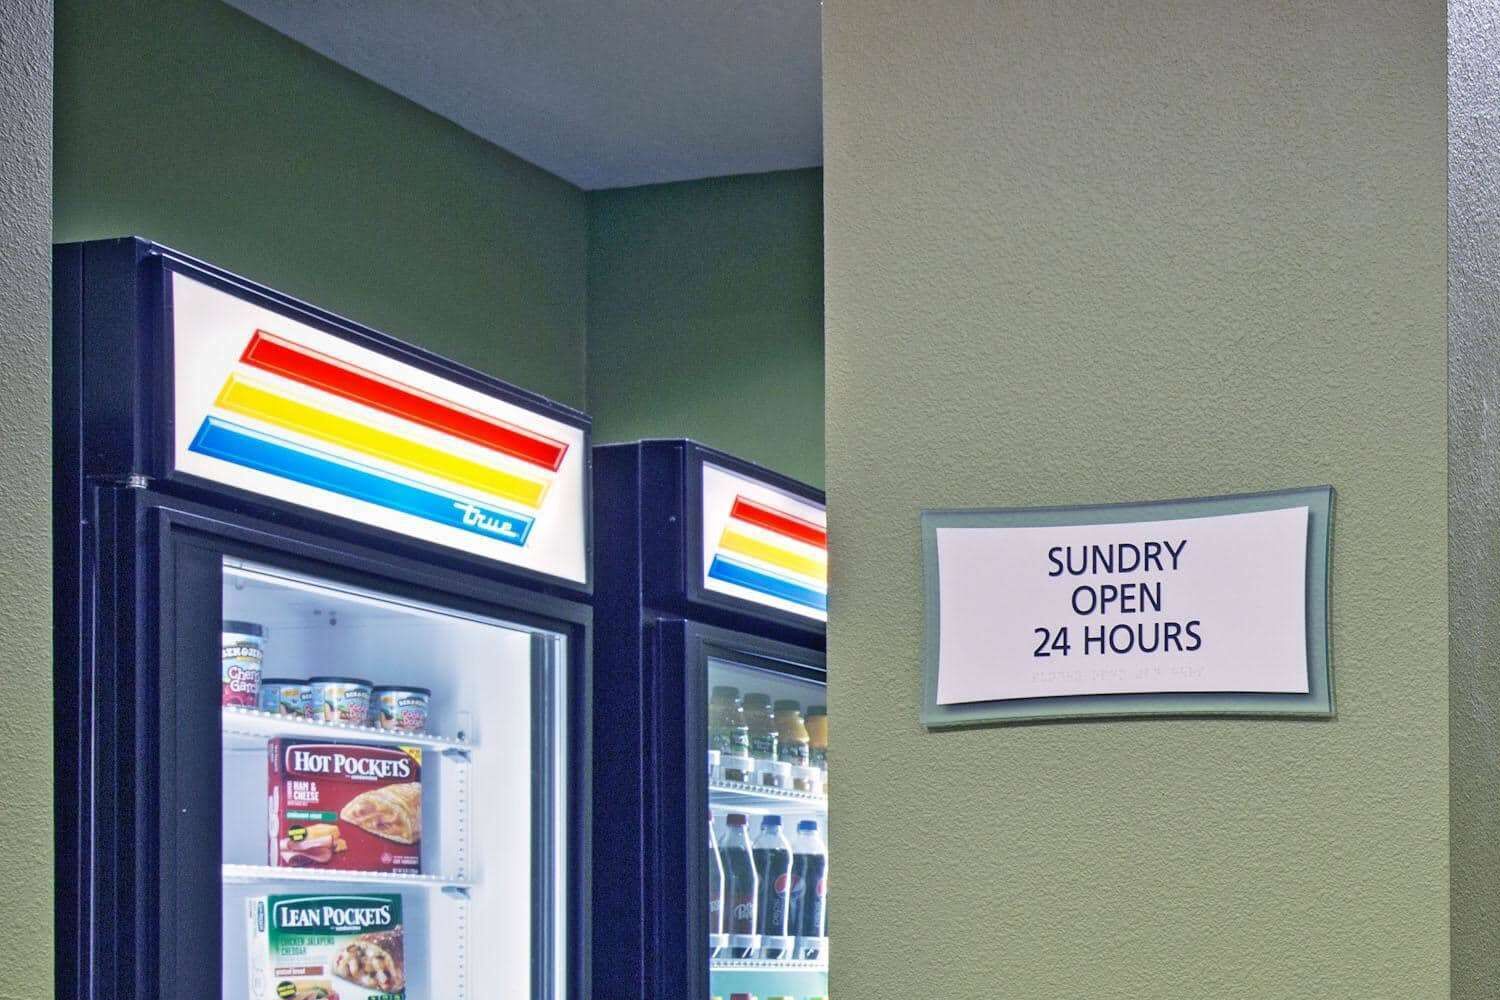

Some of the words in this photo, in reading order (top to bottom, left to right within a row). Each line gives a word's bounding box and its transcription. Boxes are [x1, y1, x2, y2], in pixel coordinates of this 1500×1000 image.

[1047, 539, 1188, 577] SUNDRY
[1071, 582, 1162, 616] OPEN
[1033, 626, 1071, 657] 24
[1083, 620, 1202, 656] HOURS
[294, 751, 331, 774] HOT
[334, 753, 410, 778] POCKETS
[294, 781, 309, 791] HAM
[310, 781, 317, 791] &
[294, 790, 319, 802] CHEESE
[281, 907, 321, 928] LEAN
[322, 905, 391, 928] POCKETS
